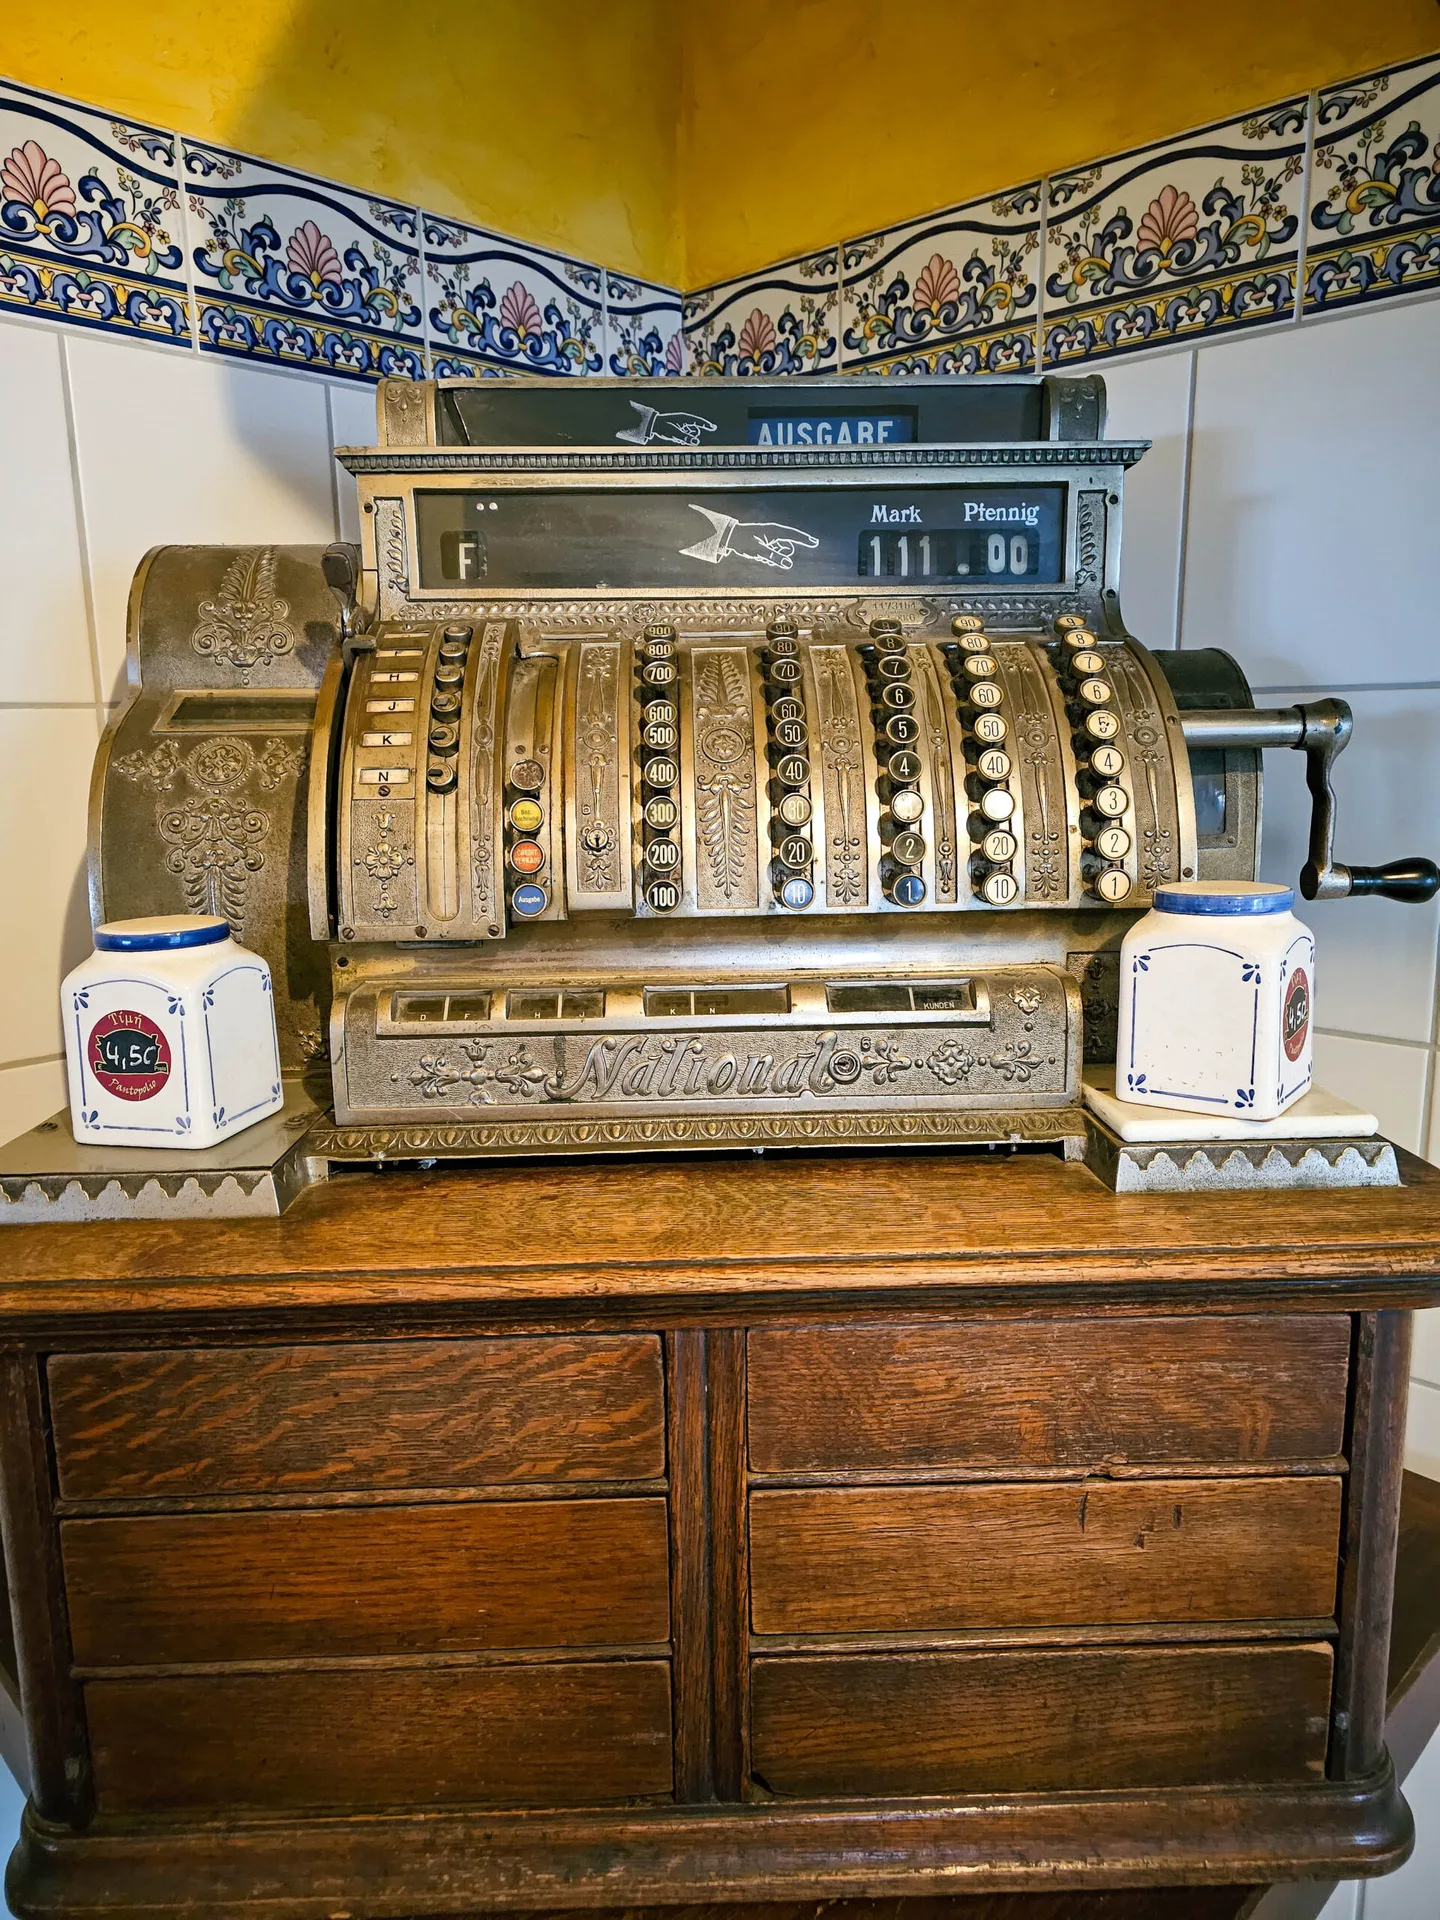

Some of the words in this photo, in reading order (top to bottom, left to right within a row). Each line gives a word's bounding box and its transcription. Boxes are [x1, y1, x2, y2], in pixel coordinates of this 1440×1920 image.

[870, 504, 923, 523] Mark
[963, 502, 1040, 526] Pfennig
[458, 543, 477, 579] F
[960, 619, 976, 627] 90
[1066, 617, 1076, 627] 9
[777, 641, 792, 653] 80
[886, 638, 895, 649] 8
[967, 637, 982, 648] 80
[1075, 633, 1085, 644] 8
[648, 644, 671, 656] 800
[780, 664, 795, 677] 70
[891, 661, 899, 675] 7
[973, 660, 989, 673] 70
[1083, 656, 1092, 669] 7
[390, 673, 400, 681] H
[650, 667, 672, 680] 700
[895, 688, 904, 704] 6
[978, 688, 995, 703] 60
[1093, 684, 1102, 700] 6
[388, 702, 397, 711] J
[649, 706, 672, 720] 600
[781, 703, 797, 719] 60
[649, 727, 673, 744] 500
[784, 725, 801, 742] 50
[898, 721, 908, 739] 5
[983, 720, 1000, 737] 50
[382, 735, 393, 745] K
[900, 757, 910, 776] 4
[987, 755, 1004, 774] 40
[1104, 752, 1114, 770] 4
[378, 771, 389, 782] N
[650, 764, 674, 782] 400
[785, 761, 803, 780] 40
[1109, 790, 1118, 810] 3
[650, 803, 674, 823] 300
[788, 800, 805, 820] 30
[905, 838, 915, 858] 2
[992, 836, 1009, 856] 20
[1110, 833, 1119, 853] 2
[651, 844, 676, 864] 200
[788, 842, 805, 862] 20
[791, 884, 806, 904] 10
[906, 880, 912, 901] 1
[994, 879, 1009, 899] 10
[1111, 876, 1117, 897] 1
[518, 896, 541, 905] Ausgabe
[652, 887, 676, 907] 100
[923, 1001, 955, 1010] KUNDEN
[861, 1036, 871, 1052] 6
[544, 1030, 838, 1100] National
[108, 1078, 157, 1100] Pantopolio
